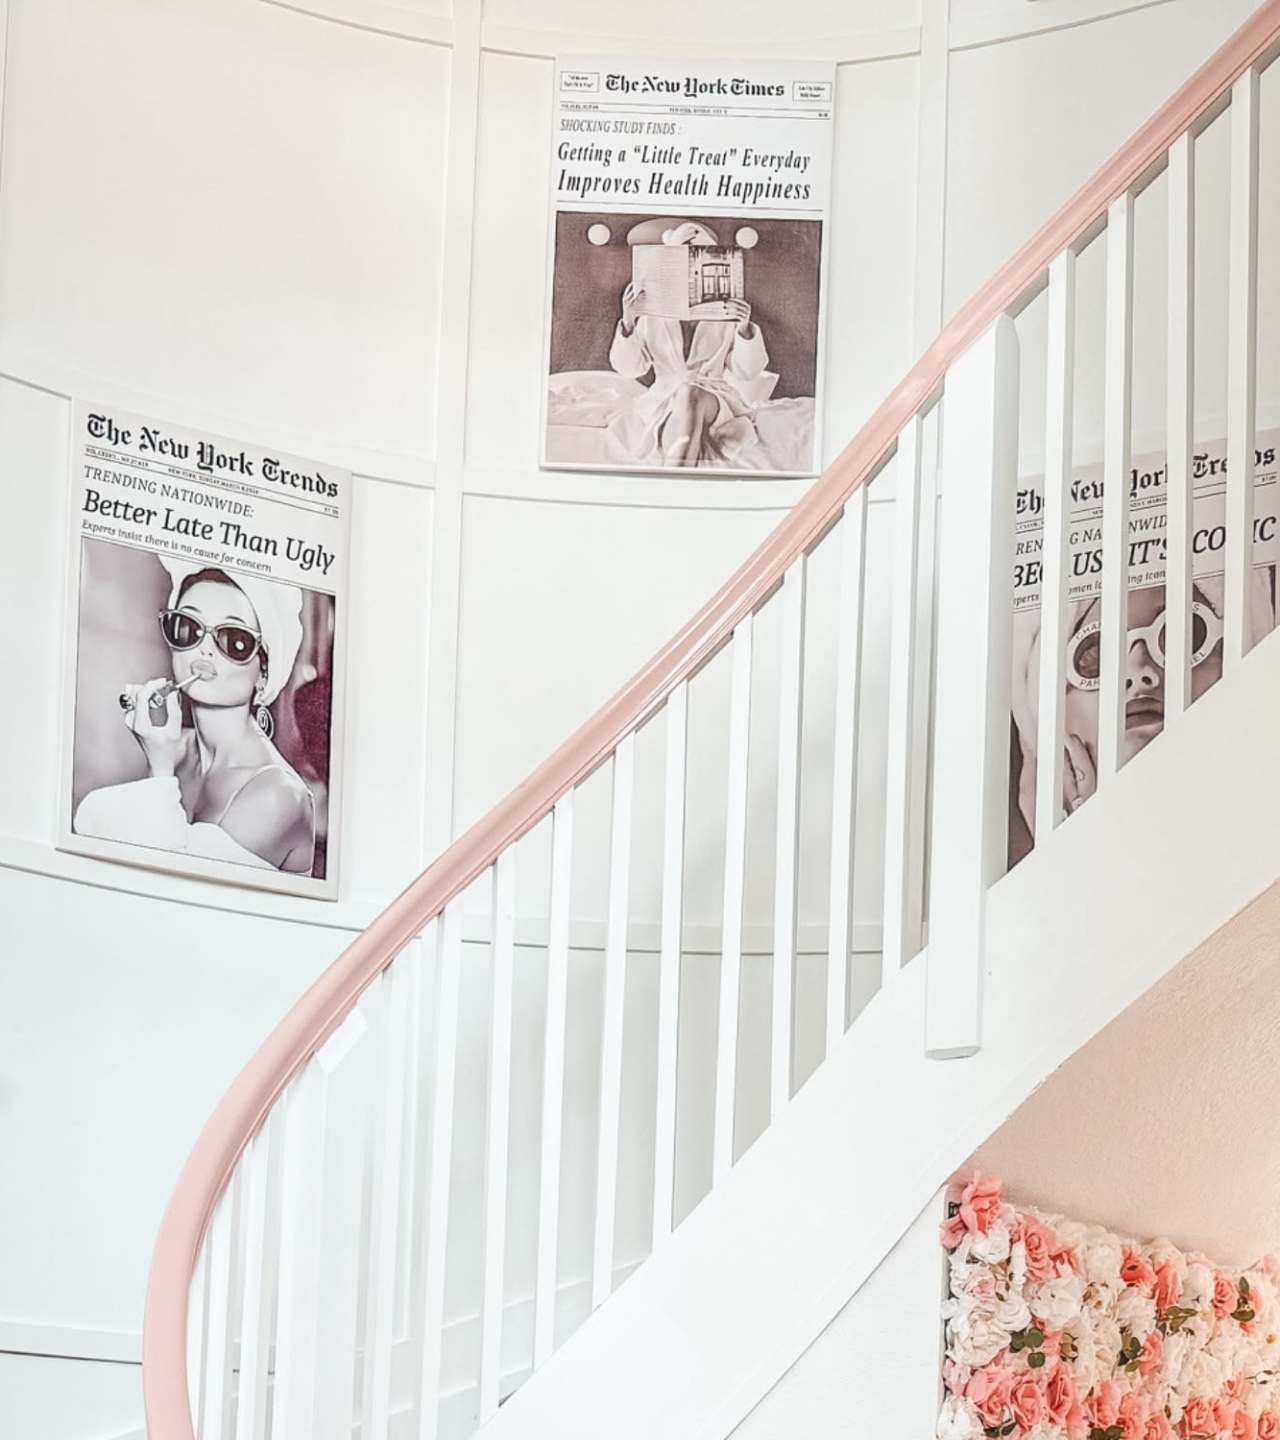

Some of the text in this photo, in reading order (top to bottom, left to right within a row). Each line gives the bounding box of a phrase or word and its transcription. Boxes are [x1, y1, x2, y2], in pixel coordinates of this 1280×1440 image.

[605, 74, 640, 95] The
[642, 75, 680, 94] New
[684, 78, 727, 98] York
[730, 78, 785, 97] Times
[560, 118, 611, 134] SHOCKING
[612, 120, 644, 135] STUDY
[558, 142, 811, 174] Getting a “Little Treat” Everyday
[558, 169, 811, 204] Improves Health Happiness
[86, 413, 132, 446] The
[139, 427, 190, 460] New
[197, 442, 254, 477] York
[262, 457, 339, 498] Trends
[83, 465, 255, 518] TRENDING NATIONWIDE:
[81, 488, 336, 575] Better Late Than Ugly
[81, 519, 272, 573] Experts insist there is no cause for concern
